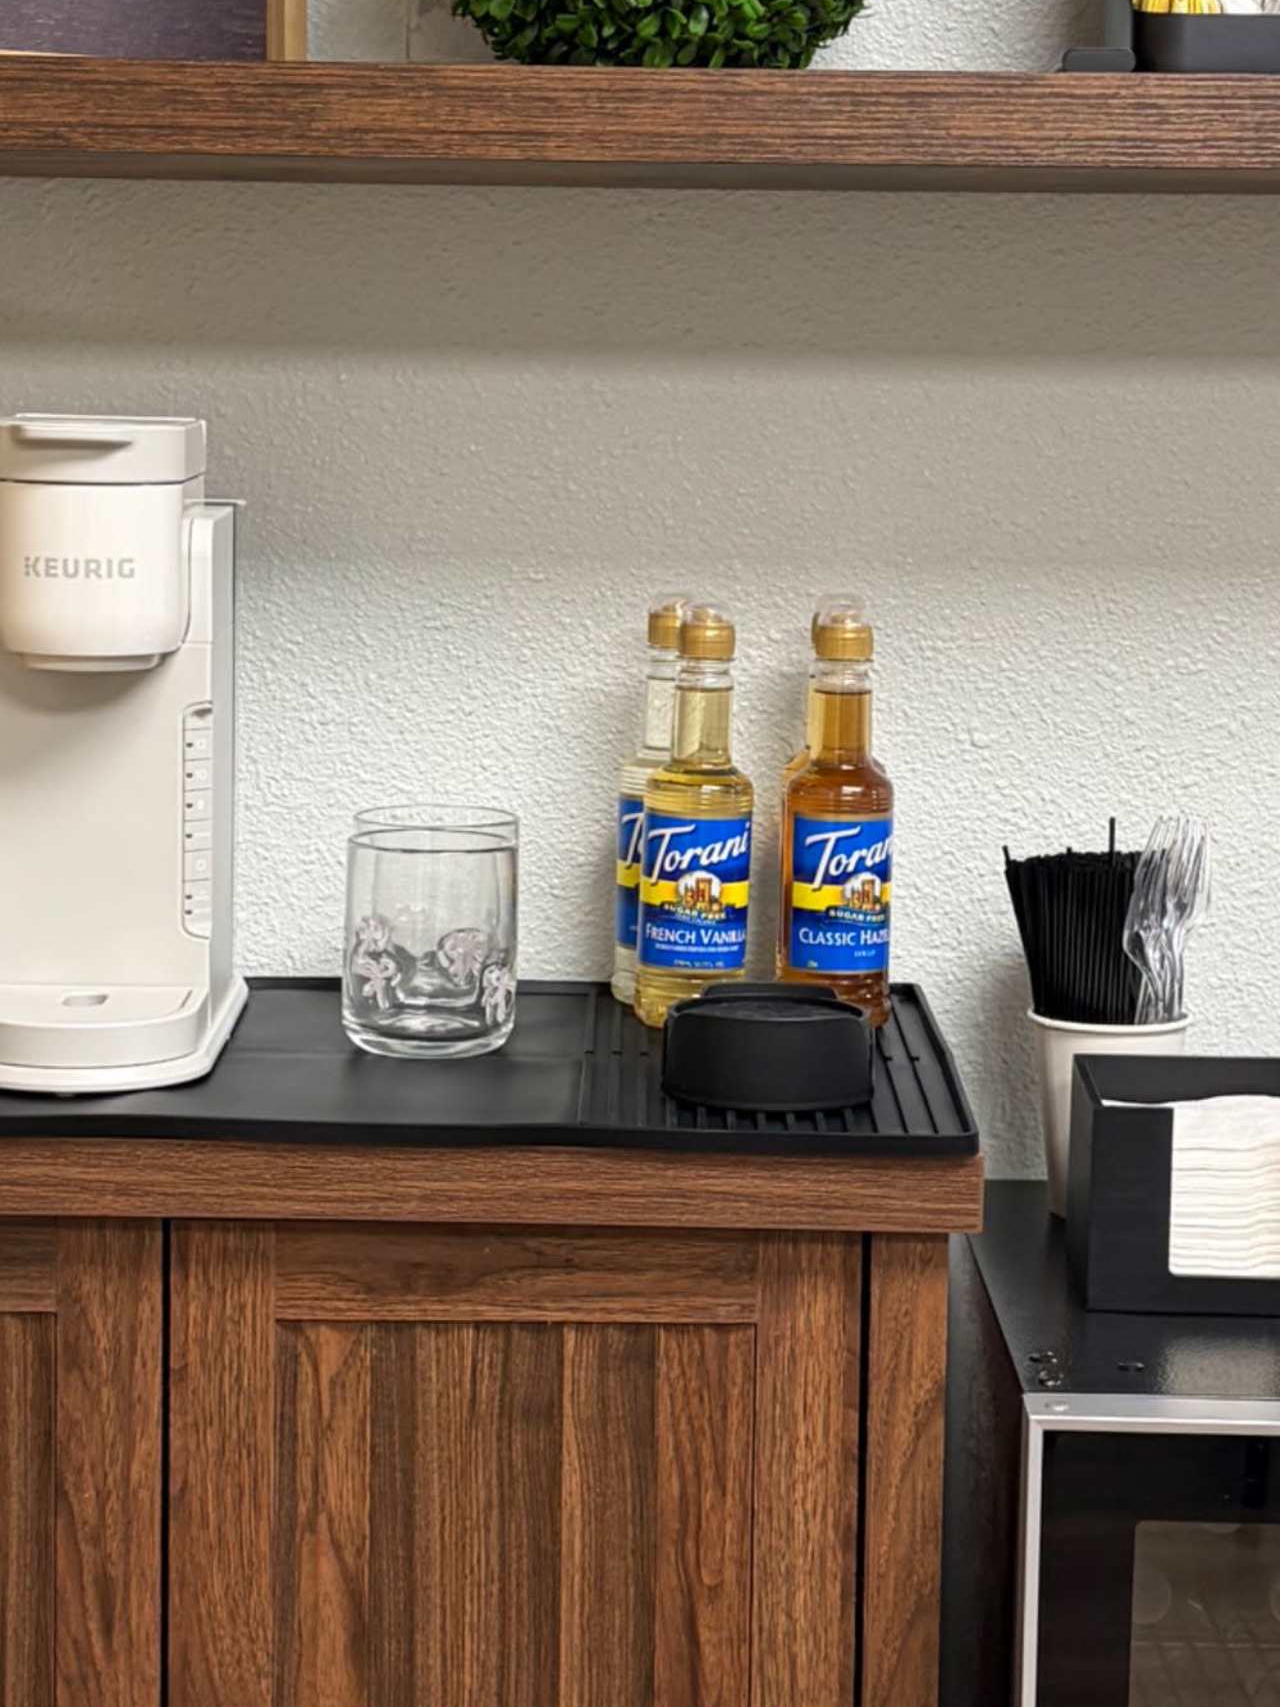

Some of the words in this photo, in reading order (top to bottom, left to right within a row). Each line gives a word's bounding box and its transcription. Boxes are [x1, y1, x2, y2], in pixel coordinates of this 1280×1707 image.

[24, 556, 136, 579] KEURIG
[647, 821, 750, 886] Torani
[645, 922, 696, 944] FRENCH
[799, 927, 857, 947] CLASSIC
